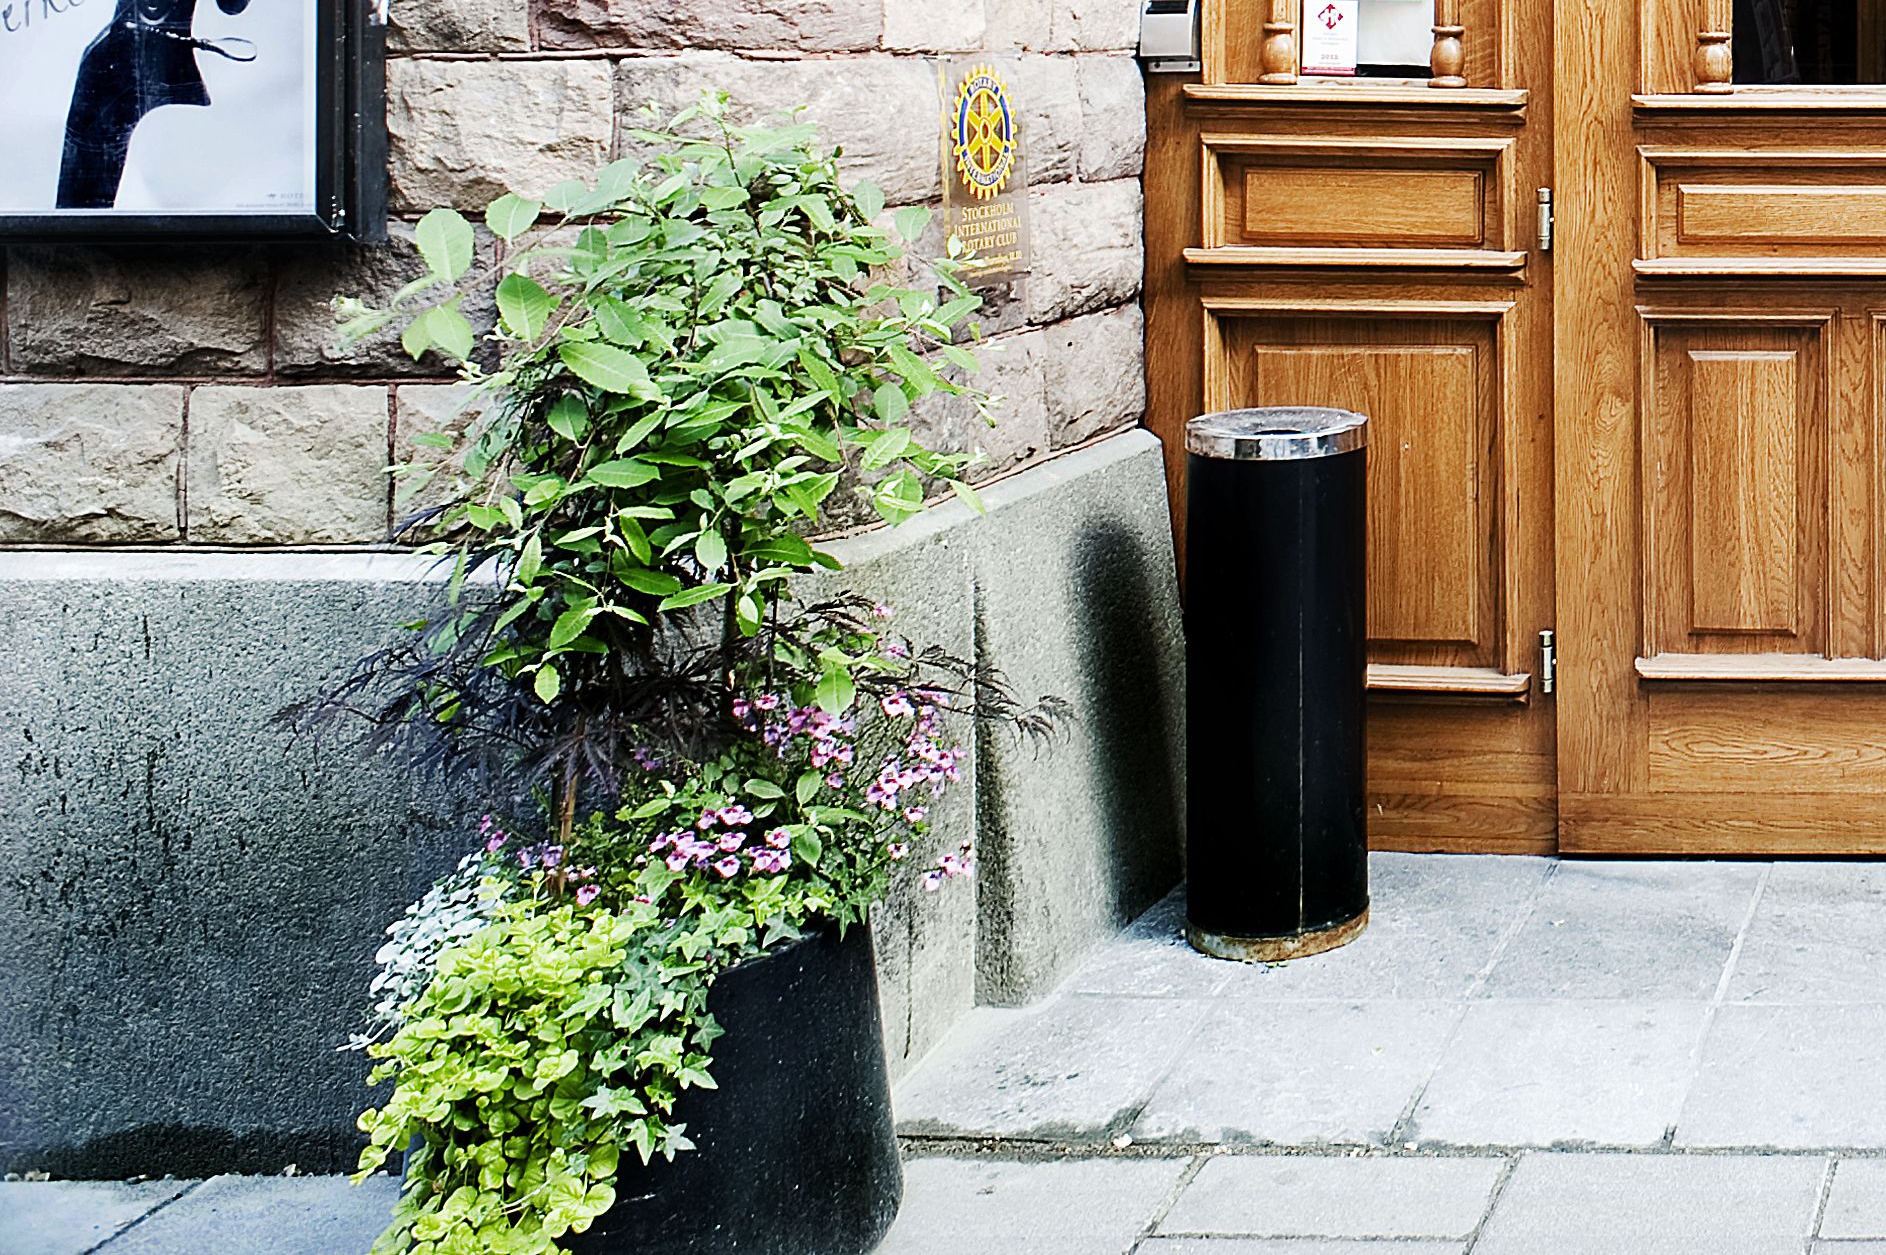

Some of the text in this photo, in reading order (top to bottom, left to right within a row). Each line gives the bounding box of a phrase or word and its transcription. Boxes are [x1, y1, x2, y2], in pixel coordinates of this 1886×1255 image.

[969, 77, 997, 95] ROTARY
[961, 202, 1014, 222] STOCKHOLM
[953, 215, 1022, 238] INTERNATIONAL
[962, 231, 1018, 253] ROTARY CLUB
